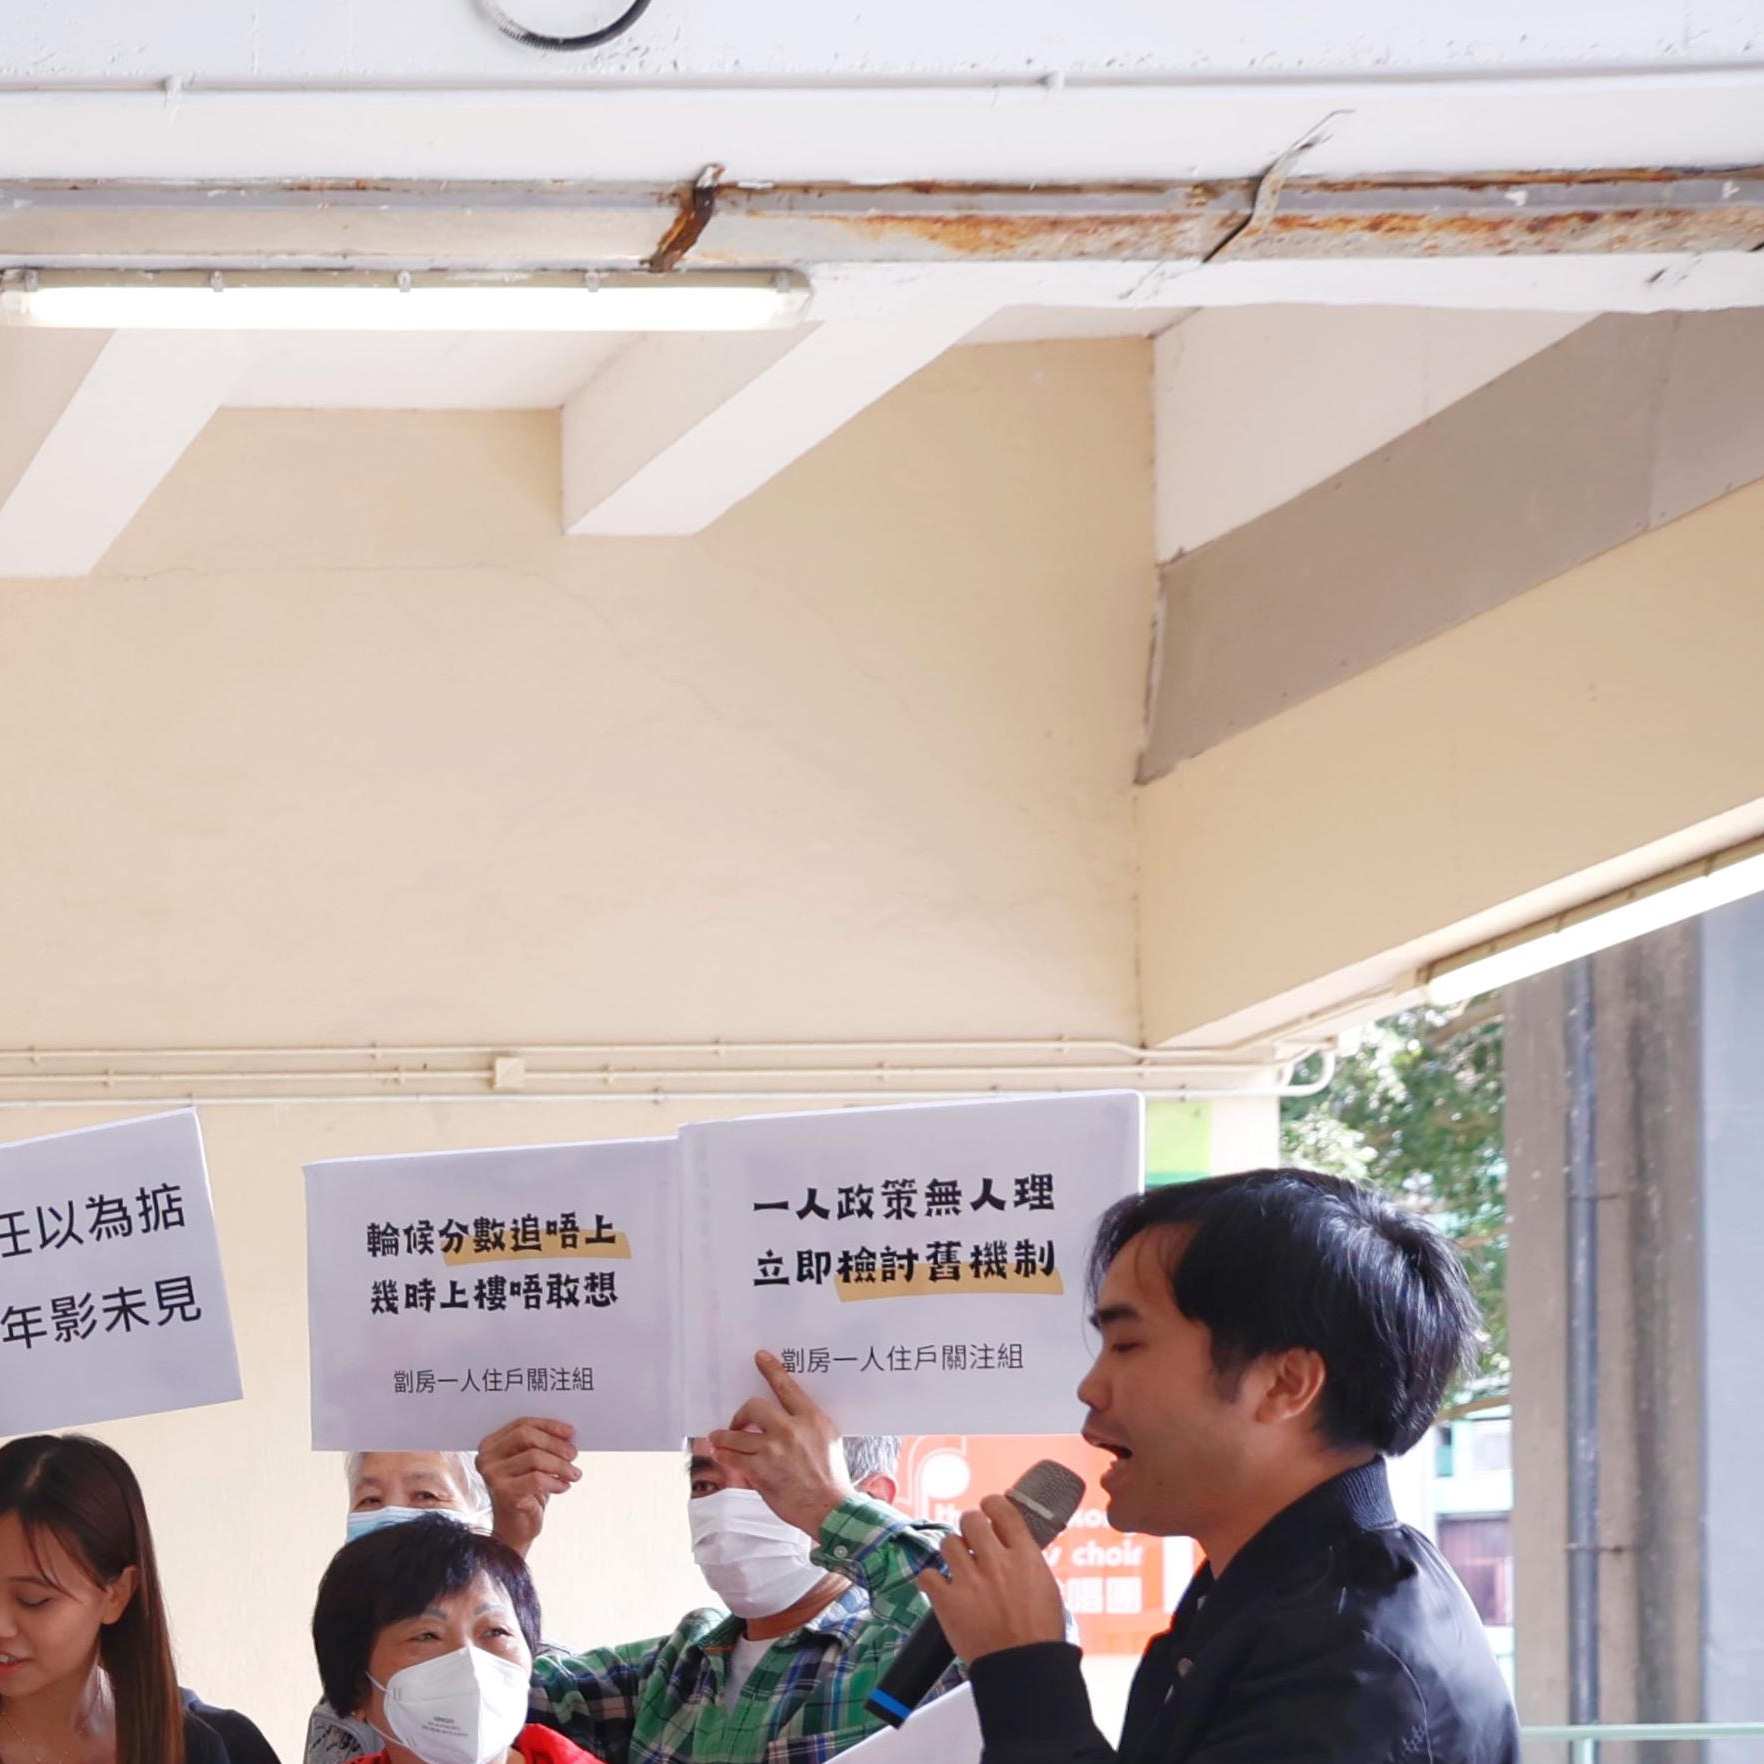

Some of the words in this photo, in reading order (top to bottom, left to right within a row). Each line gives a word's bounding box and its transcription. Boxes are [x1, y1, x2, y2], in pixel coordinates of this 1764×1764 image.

[753, 1173, 1055, 1221] 一人政策無人理
[367, 1211, 616, 1258] 輪候分數追唔上
[753, 1238, 1055, 1286] 立即檢討舊機制
[371, 1271, 618, 1315] 幾時上樓唔敢想
[393, 1367, 595, 1394] 劏房一人住戶關注組
[781, 1343, 1024, 1374] 劏房一人住戶關注組
[1072, 1539, 1144, 1568] choir
